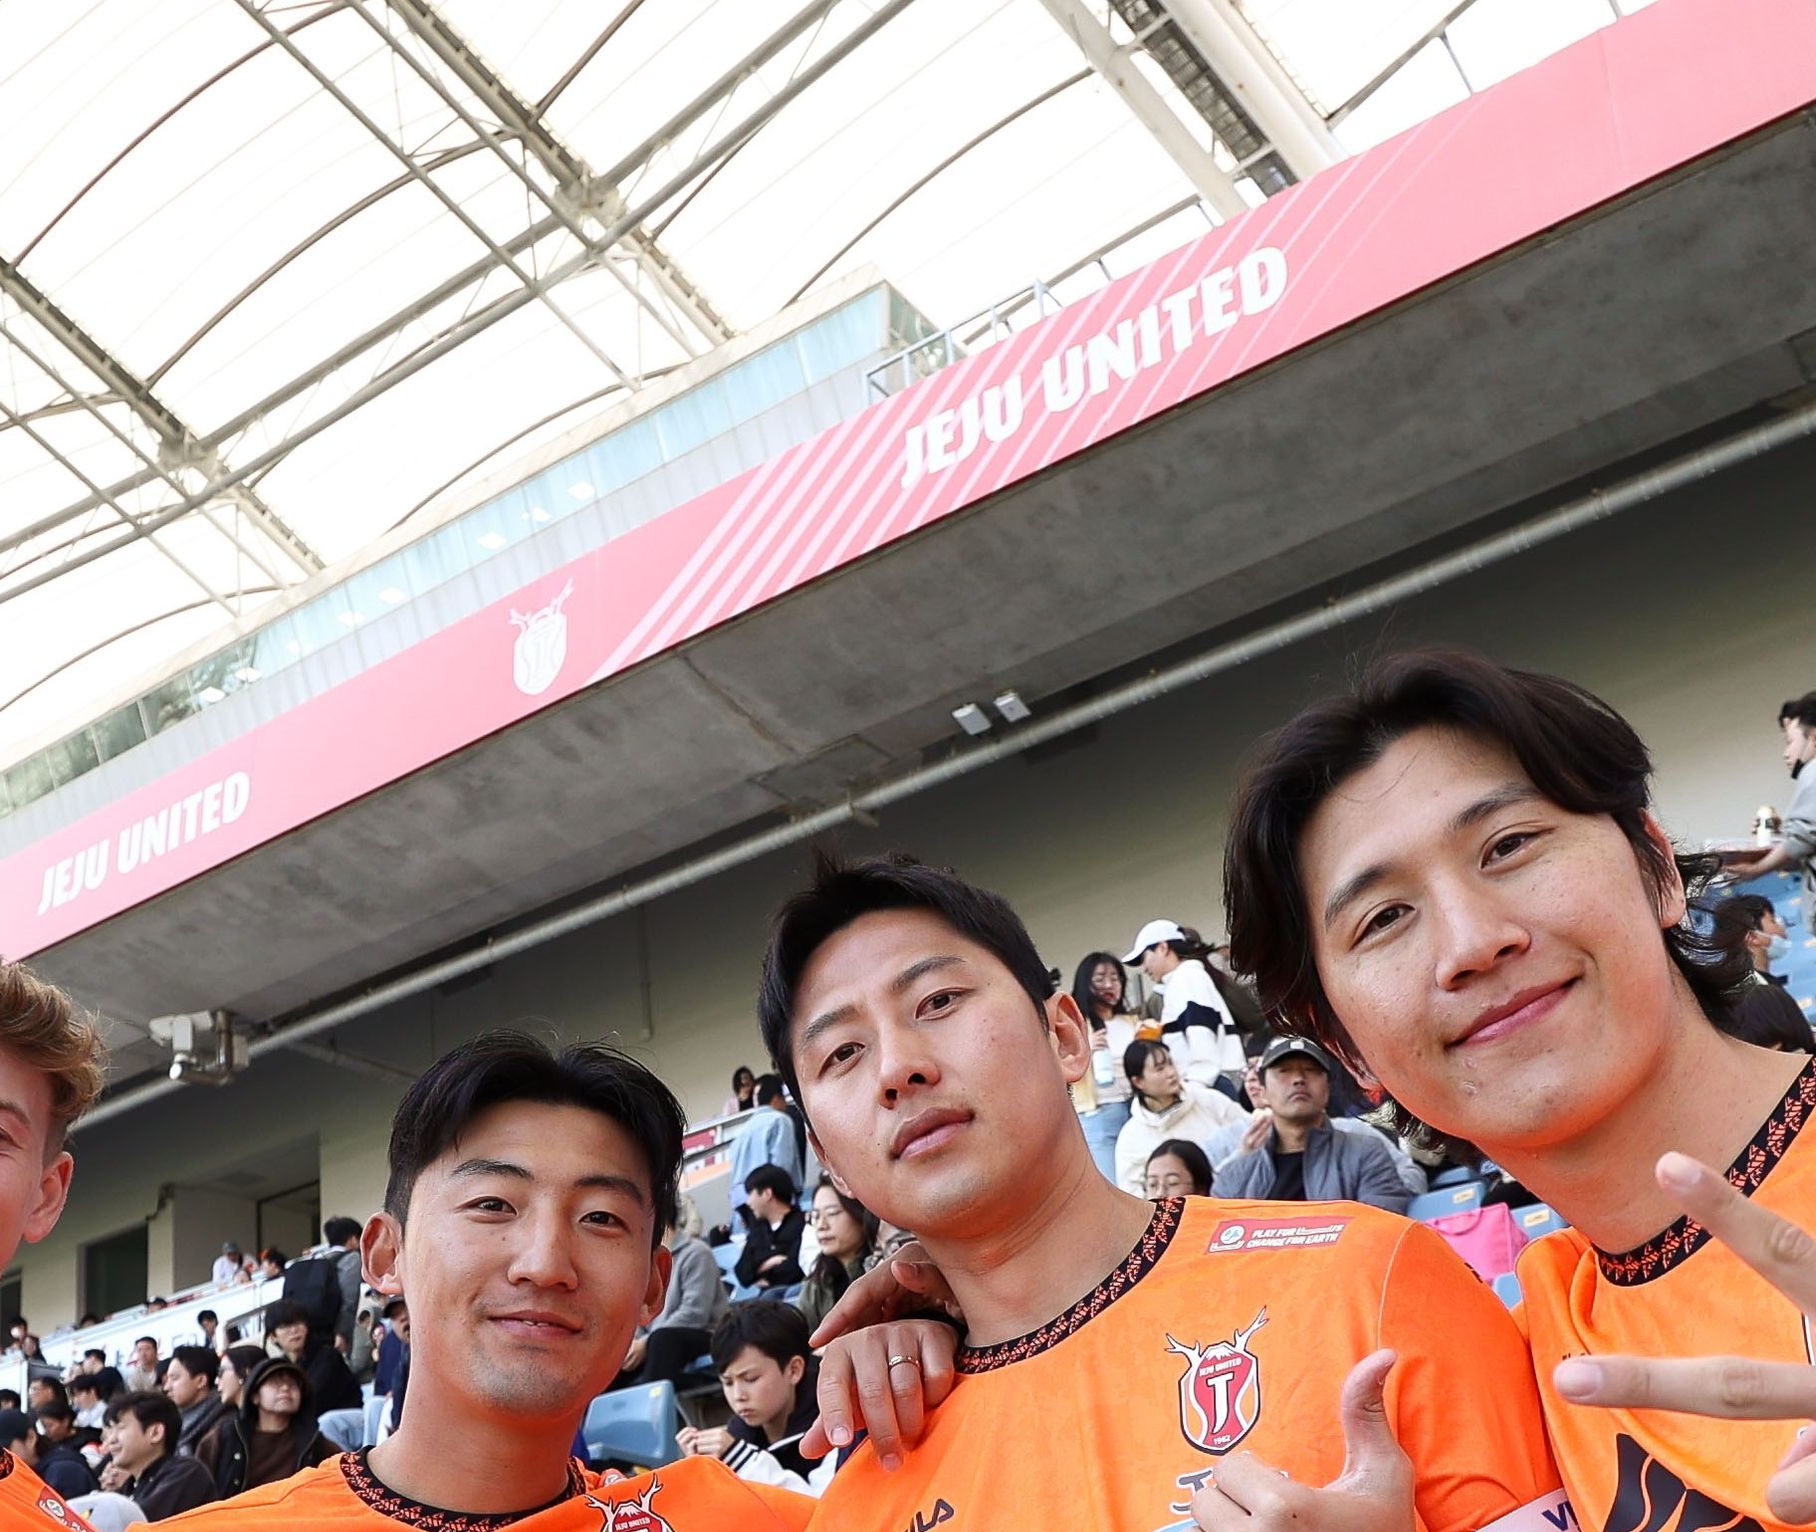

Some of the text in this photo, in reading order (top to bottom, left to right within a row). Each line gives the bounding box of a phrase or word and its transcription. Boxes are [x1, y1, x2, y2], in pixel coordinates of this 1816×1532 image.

[901, 246, 1288, 489] JEJU UNITED
[37, 771, 250, 916] JEJU UNITED
[1305, 1232, 1339, 1245] EARTH
